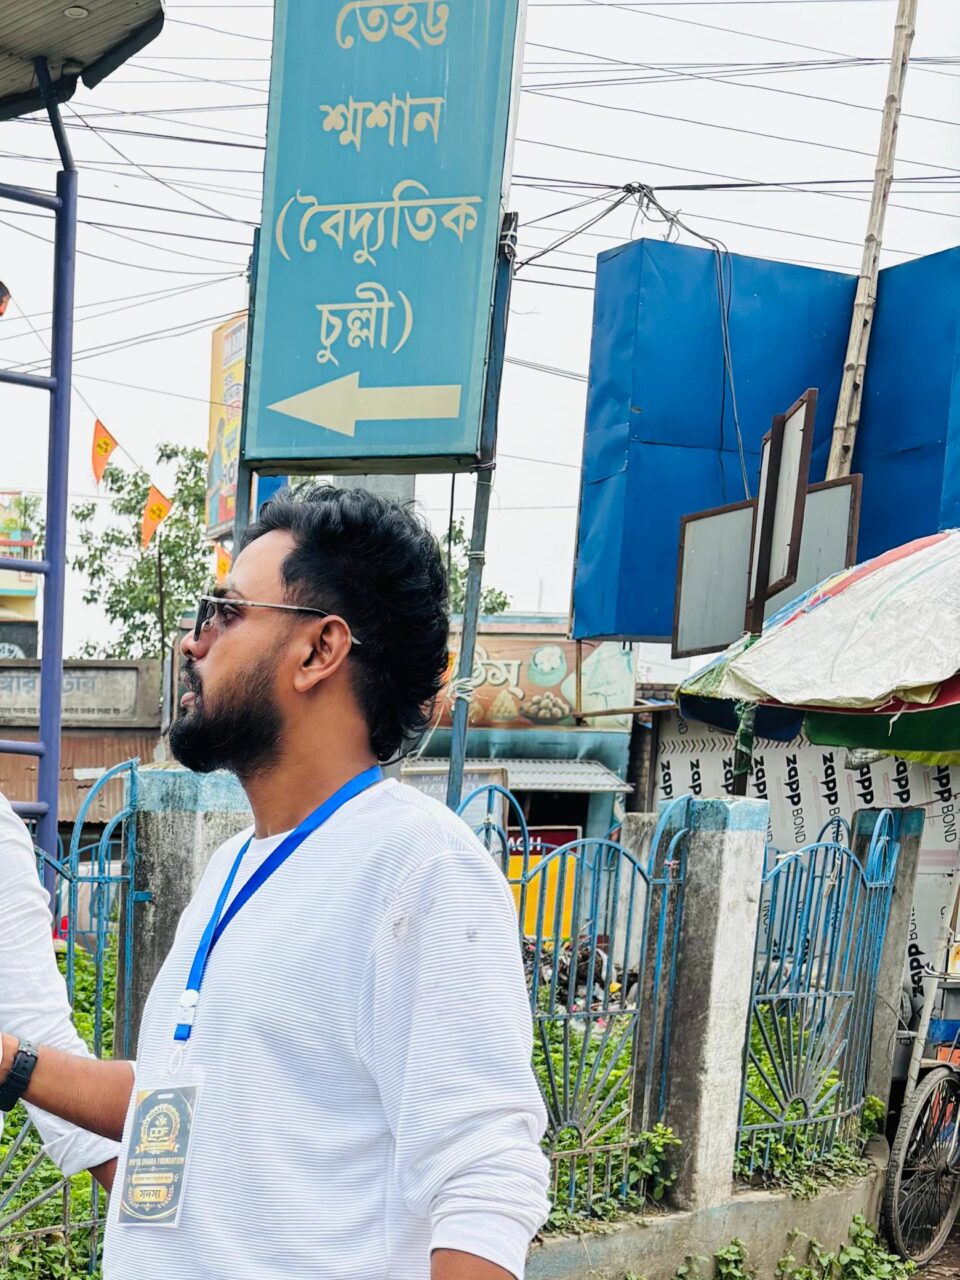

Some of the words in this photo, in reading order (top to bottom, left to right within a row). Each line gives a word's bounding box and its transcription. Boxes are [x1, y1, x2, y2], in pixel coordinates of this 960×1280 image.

[319, 91, 445, 152] শ্মশান
[785, 754, 802, 807] zapp
[821, 752, 839, 806] zapp
[855, 764, 874, 805] app
[792, 808, 806, 844] BOND
[941, 804, 957, 844] BOND
